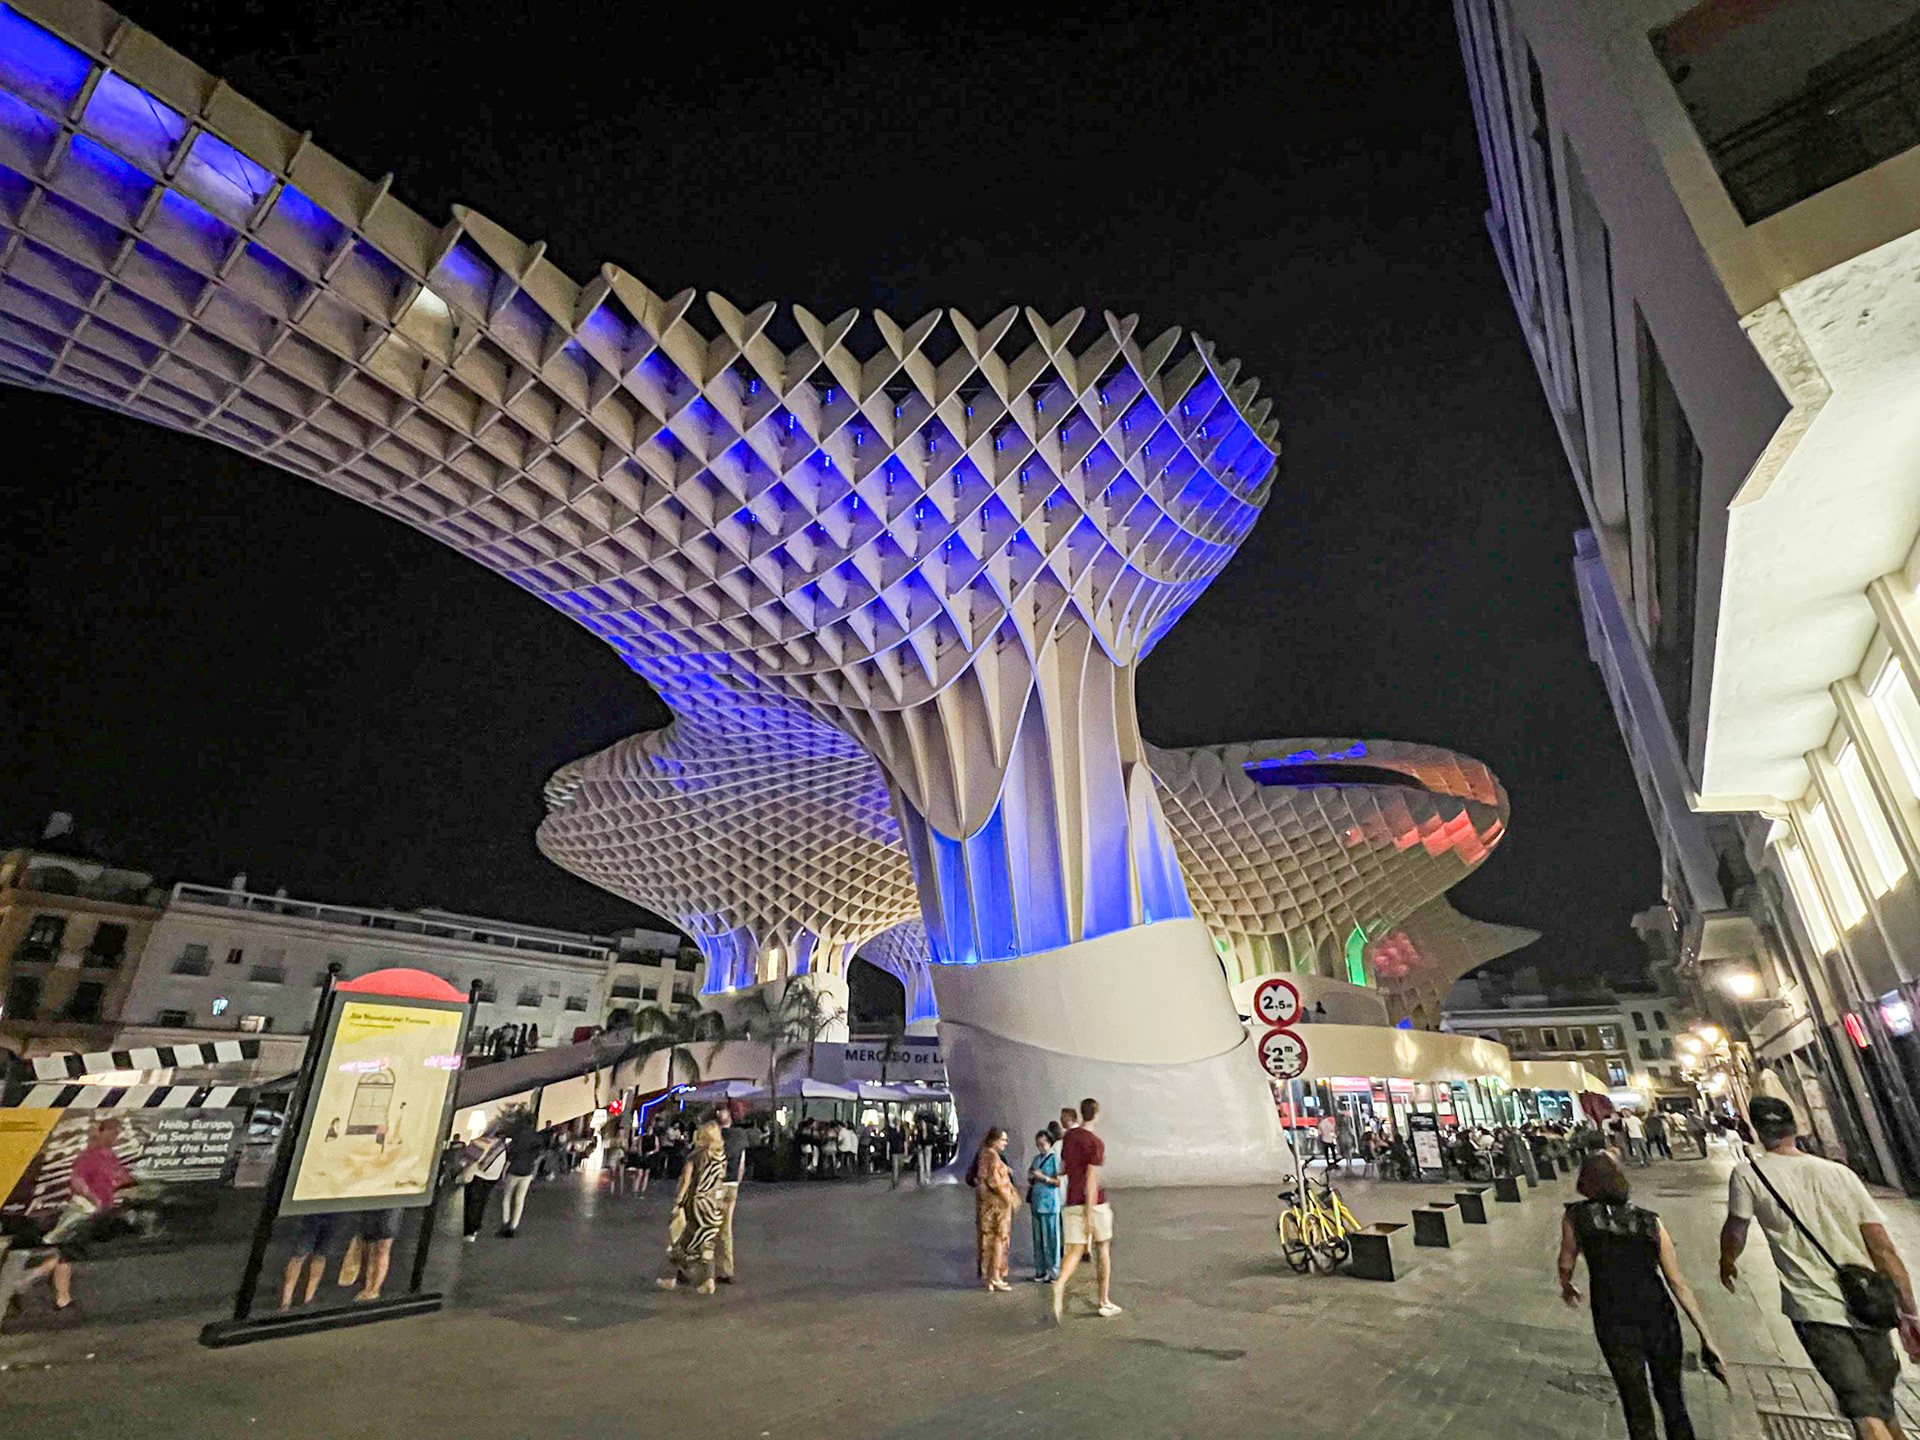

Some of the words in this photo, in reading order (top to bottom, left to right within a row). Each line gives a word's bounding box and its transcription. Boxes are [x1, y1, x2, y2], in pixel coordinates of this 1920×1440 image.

[845, 1049, 911, 1063] MERCDO
[914, 1054, 929, 1063] DE
[933, 1052, 944, 1064] L
[158, 1119, 190, 1131] Hello
[170, 1131, 208, 1141] Sevilla
[209, 1130, 233, 1141] and
[144, 1144, 179, 1156] enjoy
[180, 1143, 200, 1153] the
[202, 1143, 229, 1152] best
[153, 1157, 182, 1168] your
[183, 1156, 225, 1165] cinema
